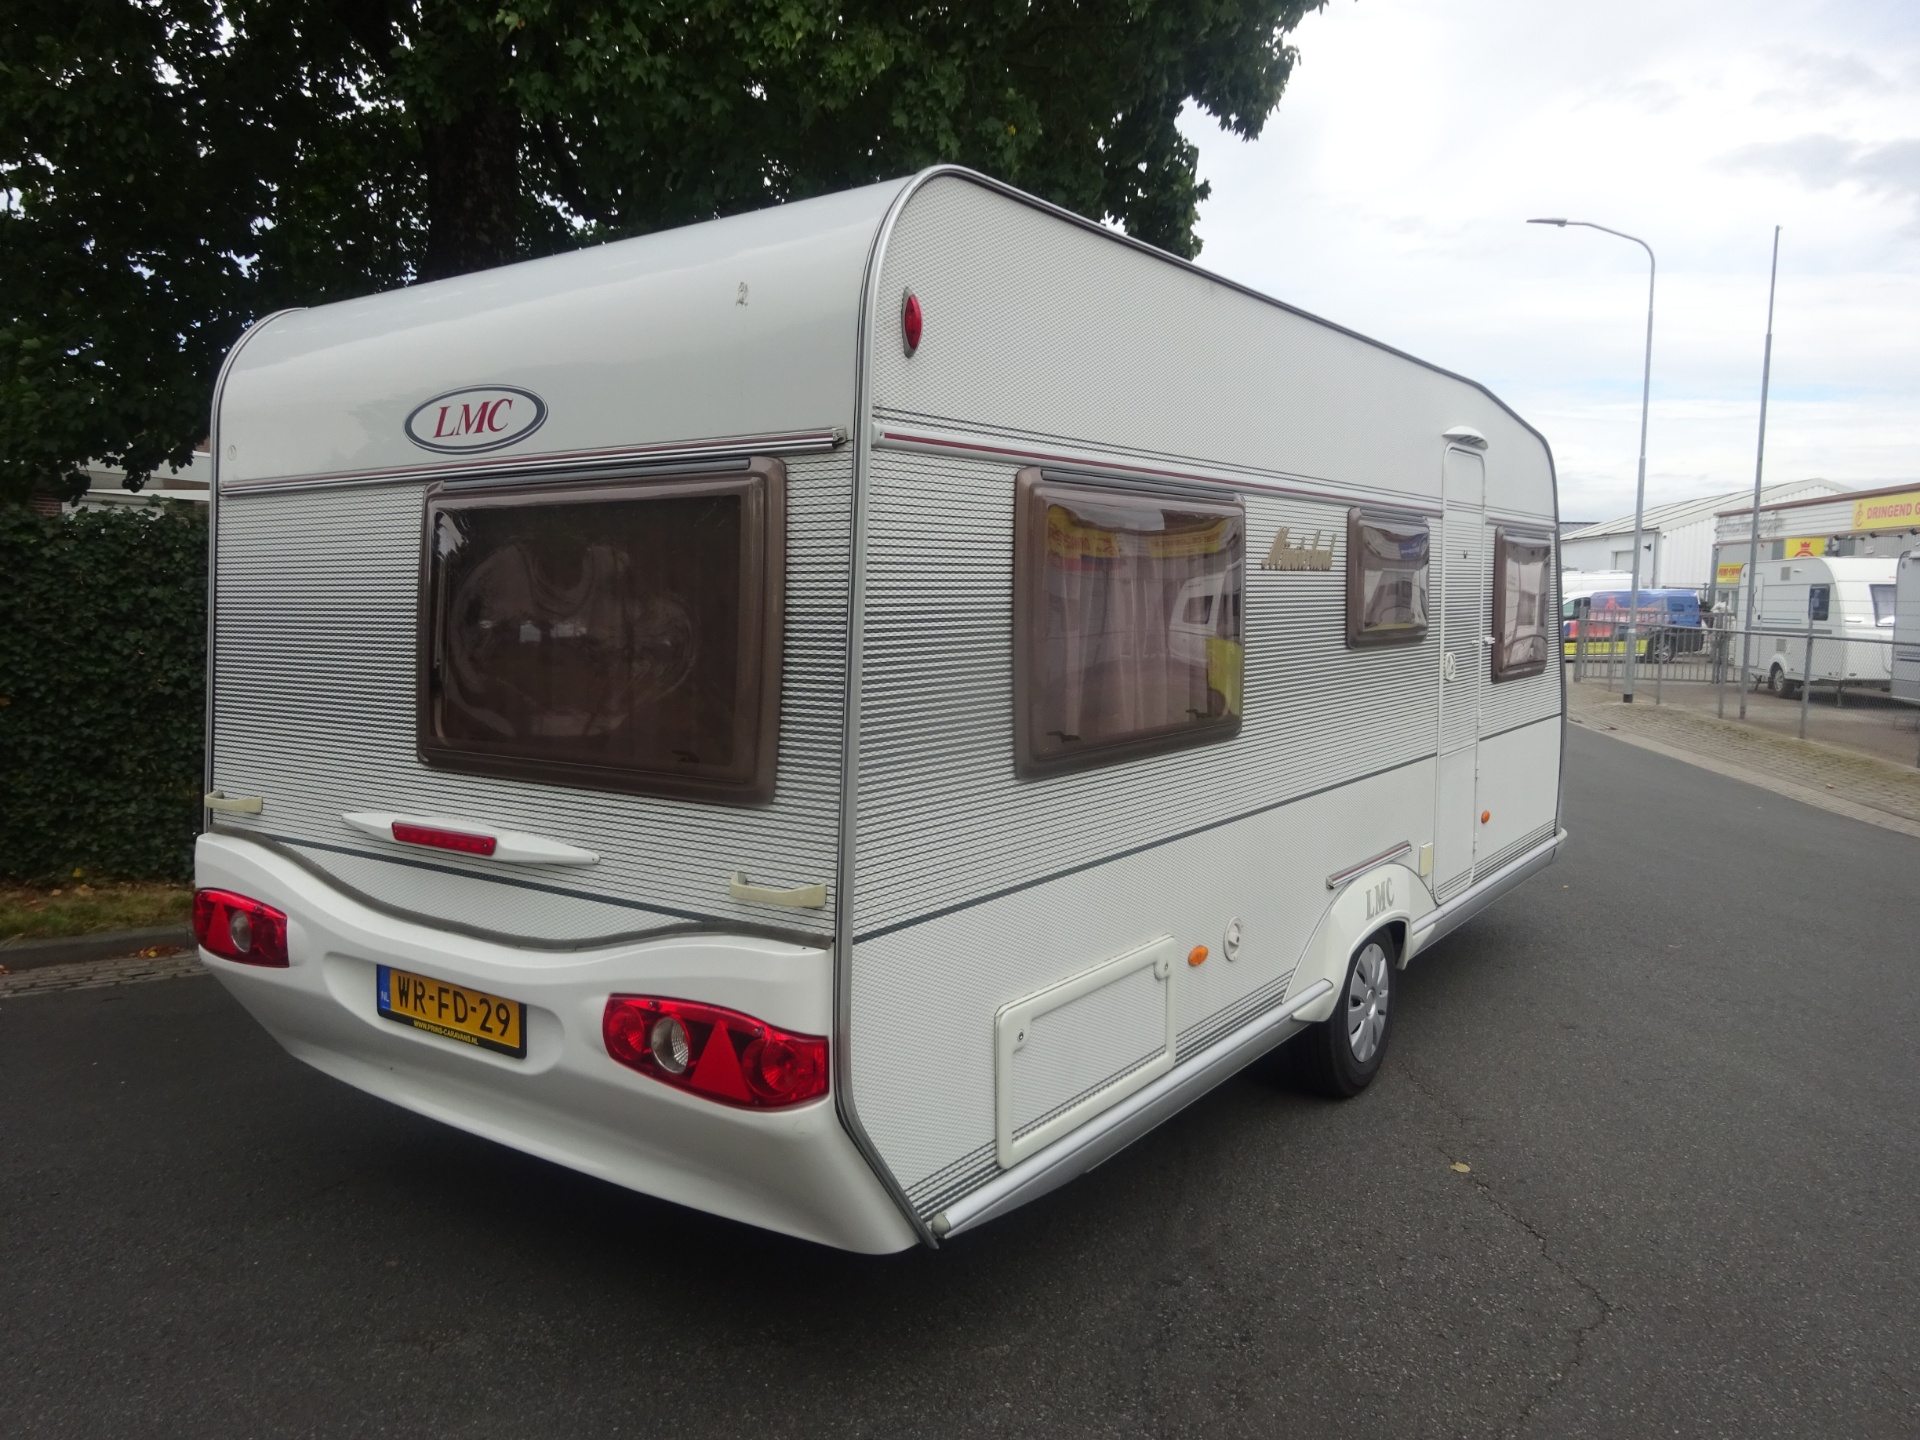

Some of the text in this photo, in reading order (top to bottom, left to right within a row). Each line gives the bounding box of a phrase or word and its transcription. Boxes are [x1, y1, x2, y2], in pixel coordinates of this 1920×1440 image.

[432, 398, 513, 438] LMC
[1867, 502, 1912, 519] DRINGEND
[1365, 876, 1394, 921] LMC
[380, 990, 390, 1002] NL
[397, 975, 511, 1037] WR-FD-29
[413, 1019, 479, 1045] WWW.PRINS-CARAVANS.NL
